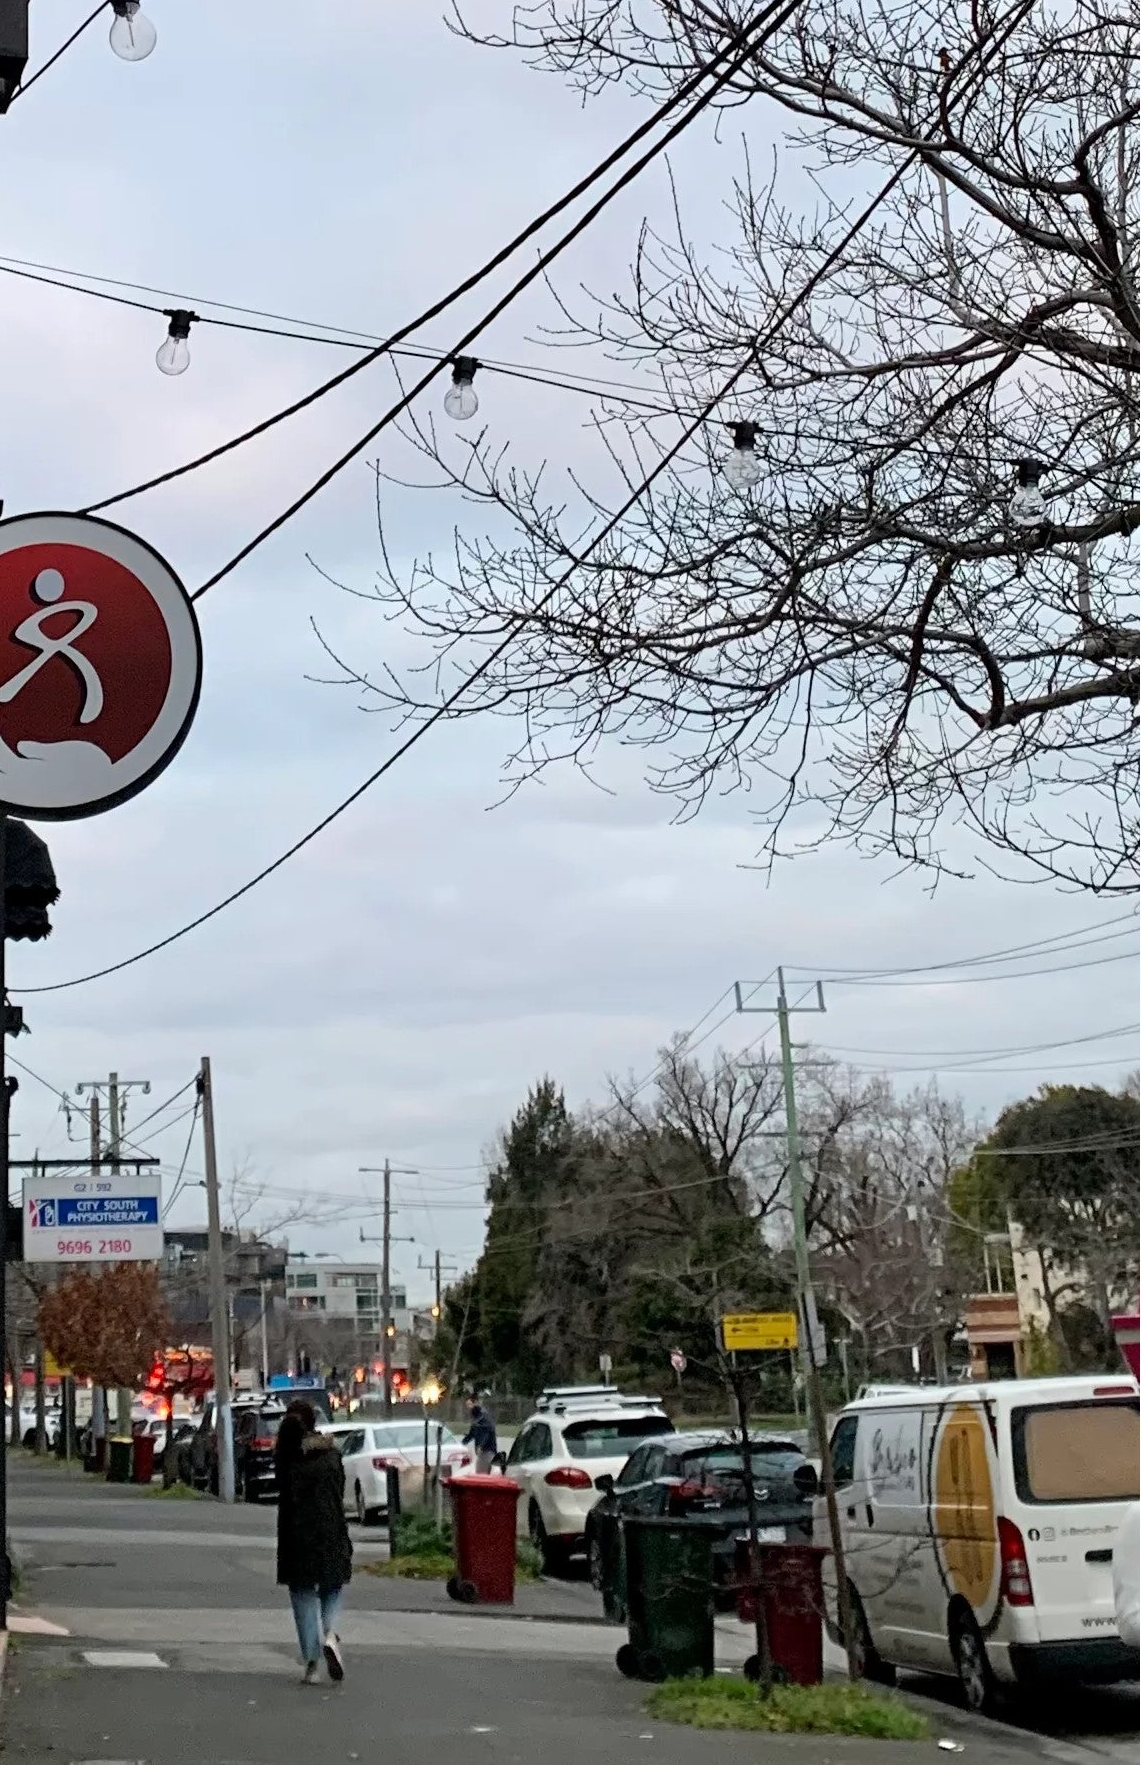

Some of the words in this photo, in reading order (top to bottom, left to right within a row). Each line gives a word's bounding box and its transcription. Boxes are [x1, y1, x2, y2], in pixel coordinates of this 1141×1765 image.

[76, 1200, 99, 1212] CITY
[104, 1199, 139, 1211] SOUTH
[67, 1211, 149, 1223] PHYSIOTHERAPY
[57, 1240, 93, 1255] 9696
[99, 1239, 132, 1254] 2180
